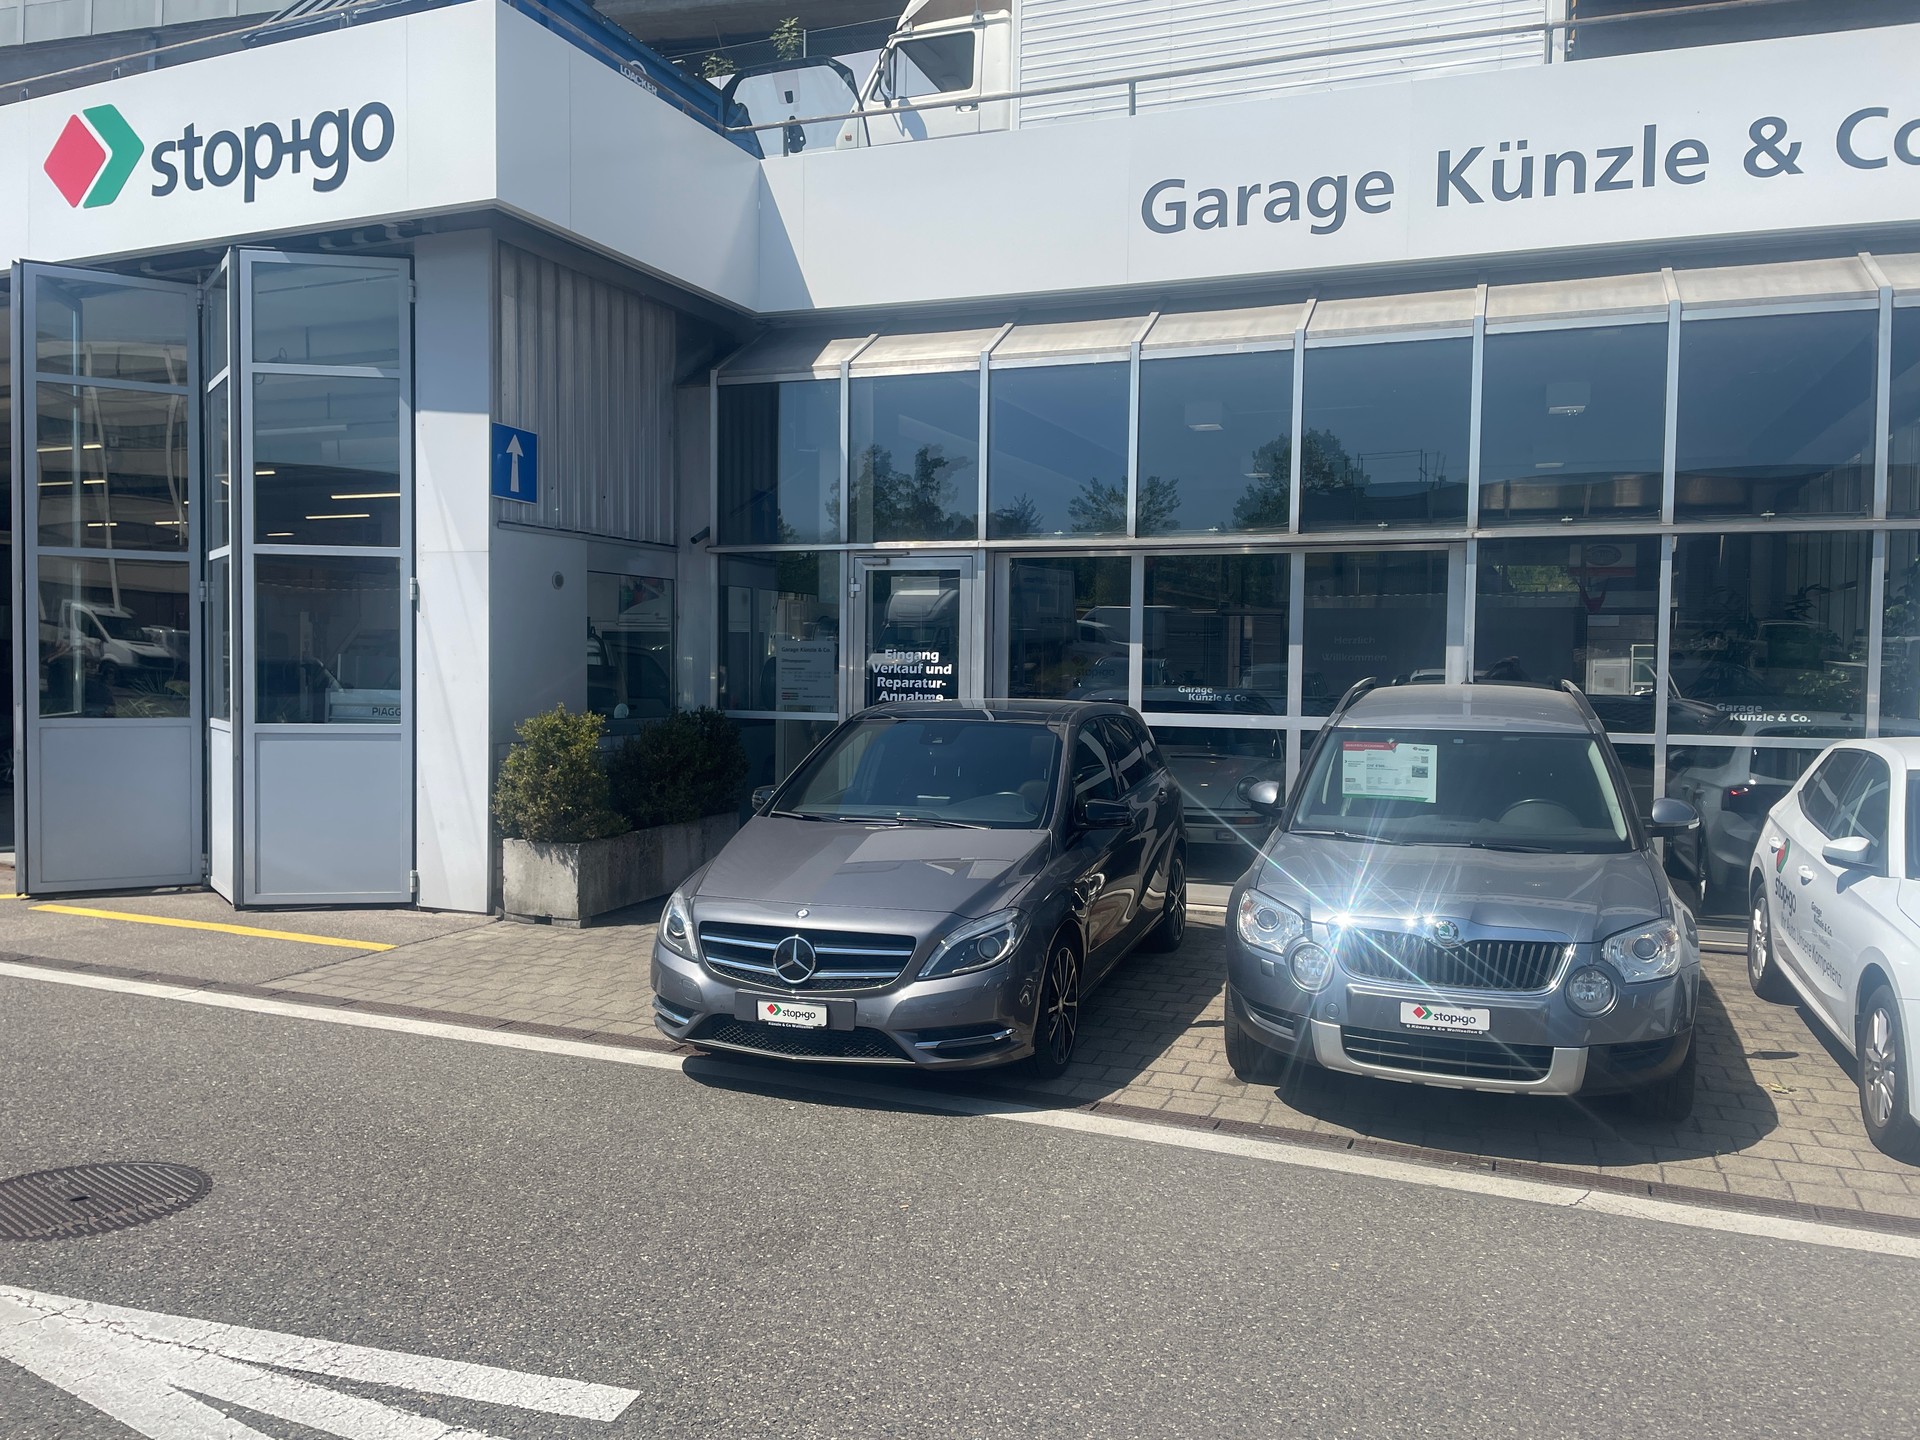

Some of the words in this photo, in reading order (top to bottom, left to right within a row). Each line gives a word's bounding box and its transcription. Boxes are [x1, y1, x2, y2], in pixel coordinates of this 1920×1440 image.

[620, 64, 658, 96] LOACKER
[151, 101, 395, 203] stop+go
[1141, 170, 1395, 235] Garage
[1436, 123, 1710, 207] Künzle
[1743, 116, 1804, 178] &
[885, 649, 939, 663] Eingang
[872, 663, 923, 674] Verkauf
[926, 664, 952, 674] und
[877, 677, 946, 690] Reparatur-
[1178, 685, 1213, 695] Garage
[1188, 693, 1222, 701] Künzle
[1716, 703, 1762, 714] Garage
[1729, 711, 1775, 722] Künzle
[1777, 713, 1787, 722] &
[1790, 713, 1811, 723] Co.
[1775, 876, 1797, 918] stop+go
[783, 1009, 816, 1021] stop+go
[1434, 1012, 1476, 1026] stop+go
